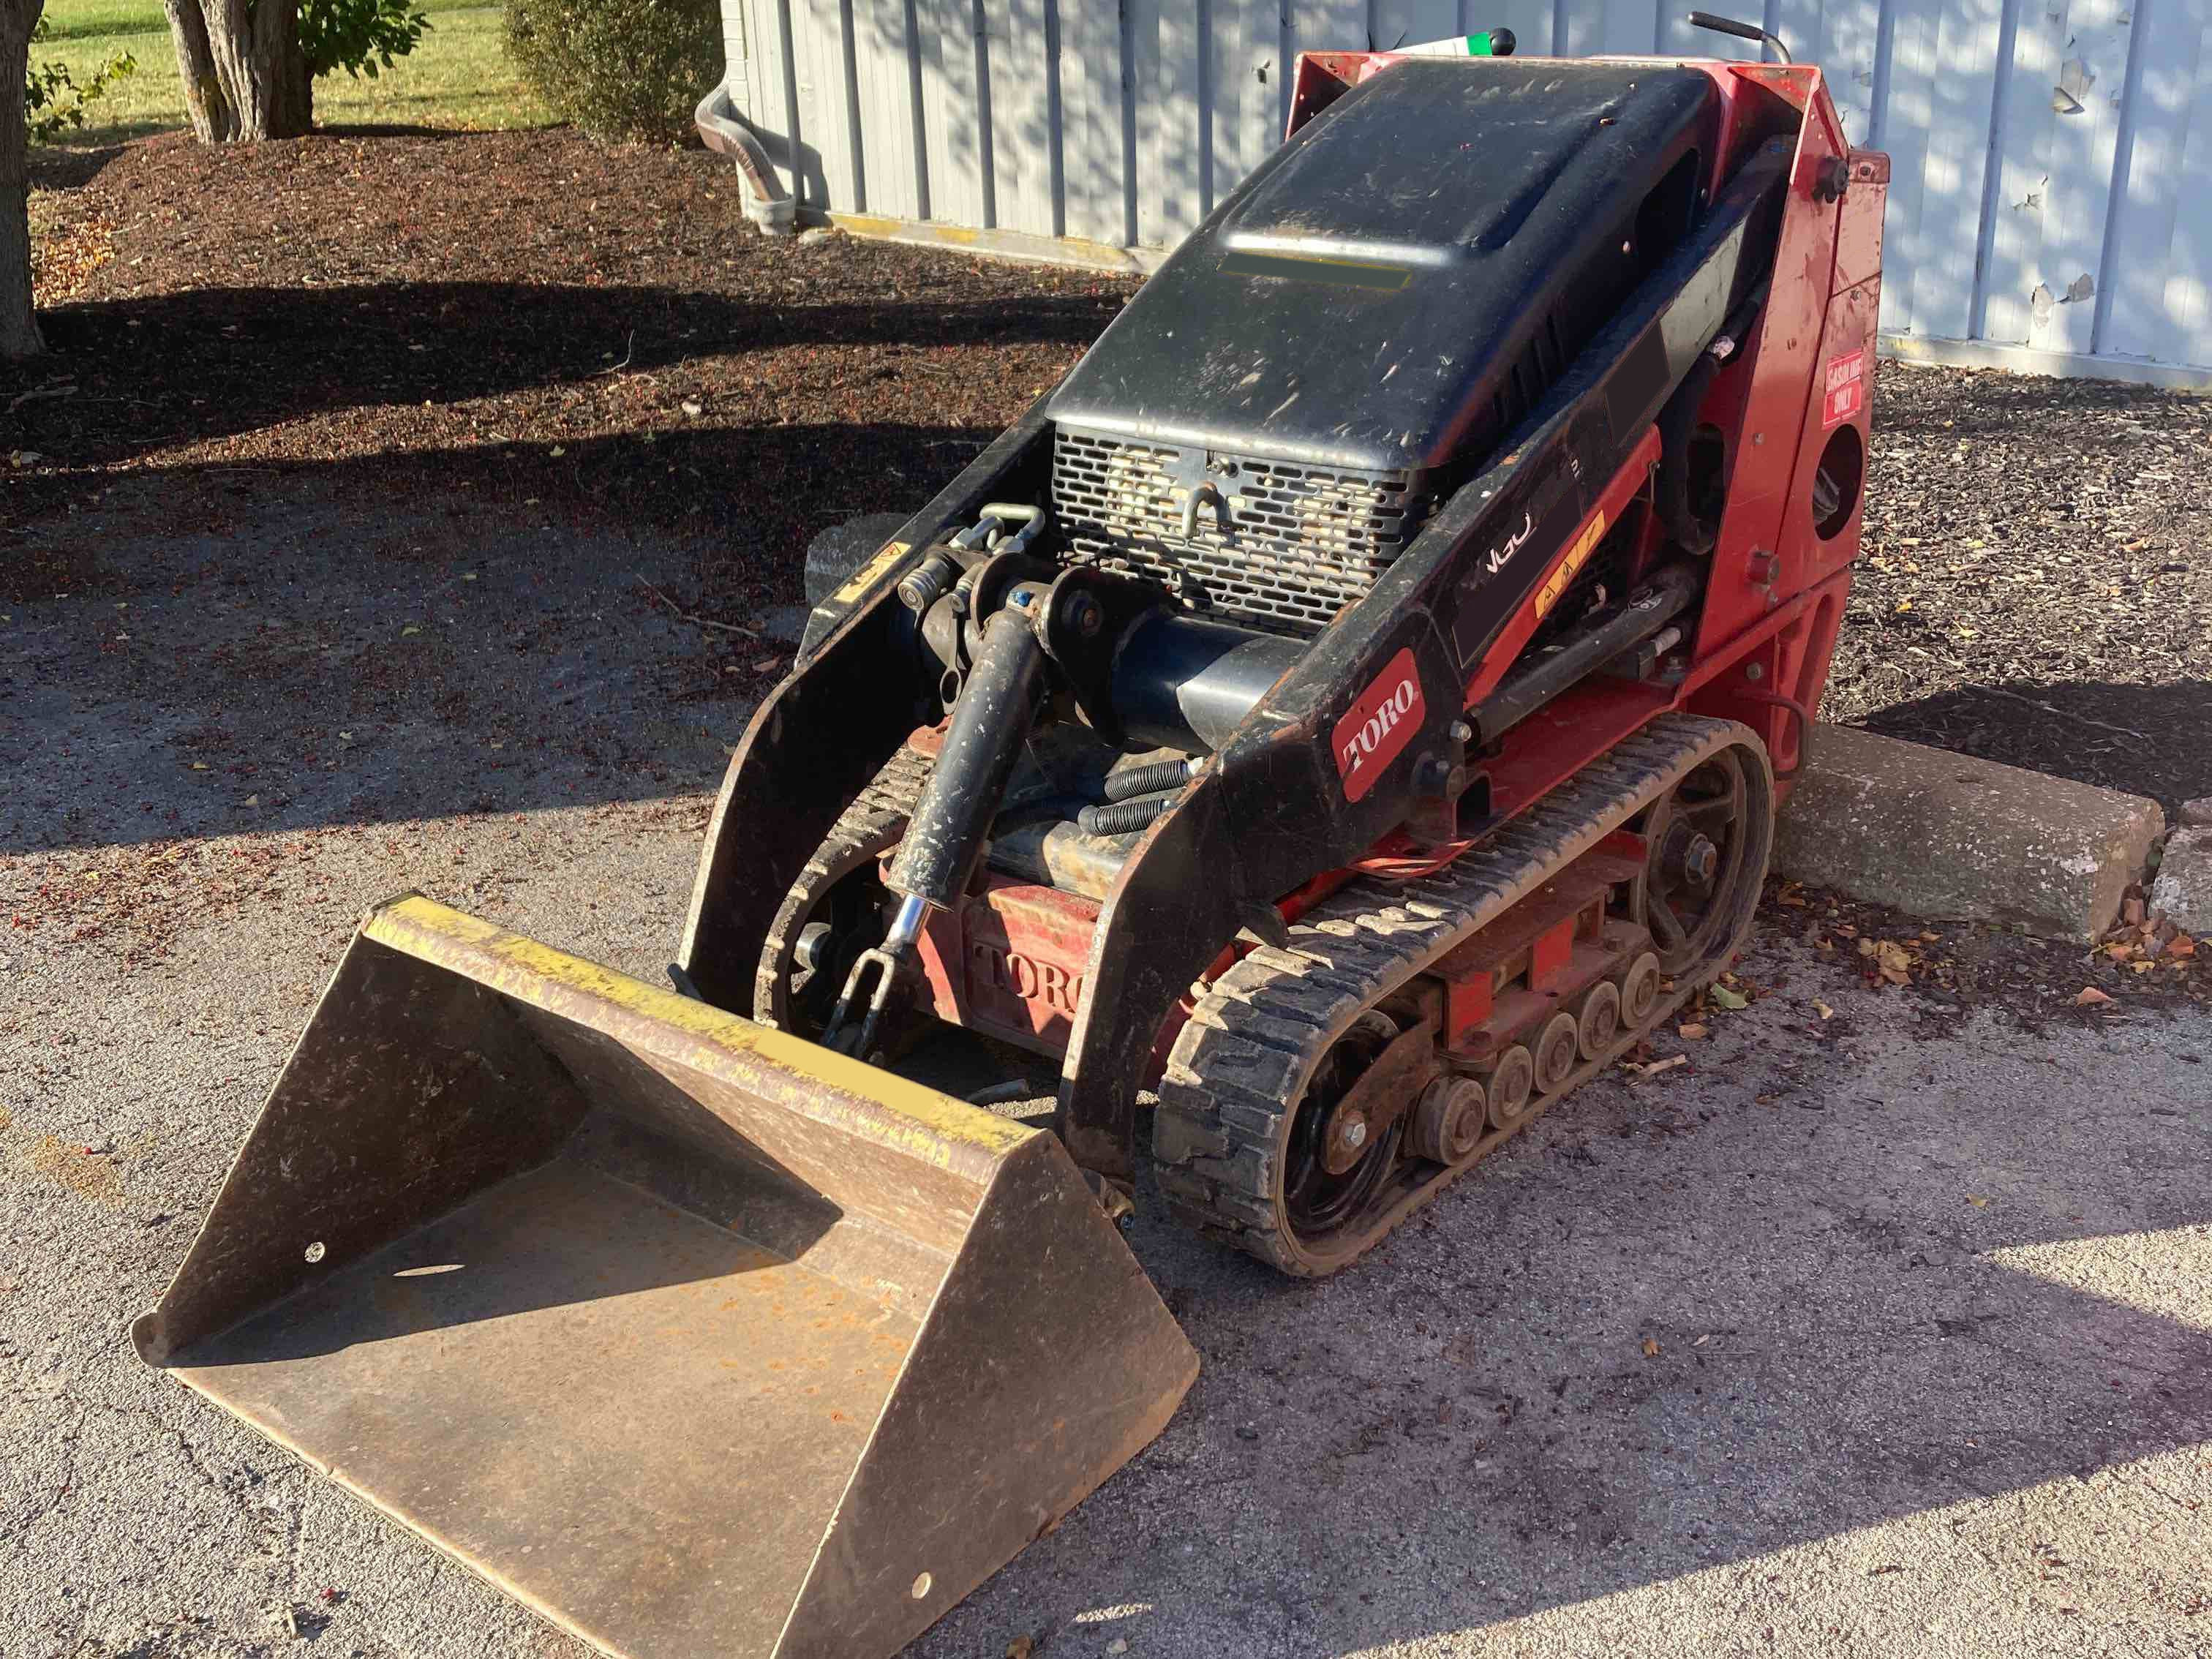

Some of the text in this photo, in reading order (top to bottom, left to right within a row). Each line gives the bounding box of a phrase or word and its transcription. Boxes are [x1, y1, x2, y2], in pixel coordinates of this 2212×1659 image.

[1826, 358, 1862, 392] GASOLINE
[1834, 386, 1852, 414] ONLY
[1342, 680, 1414, 773] TORO
